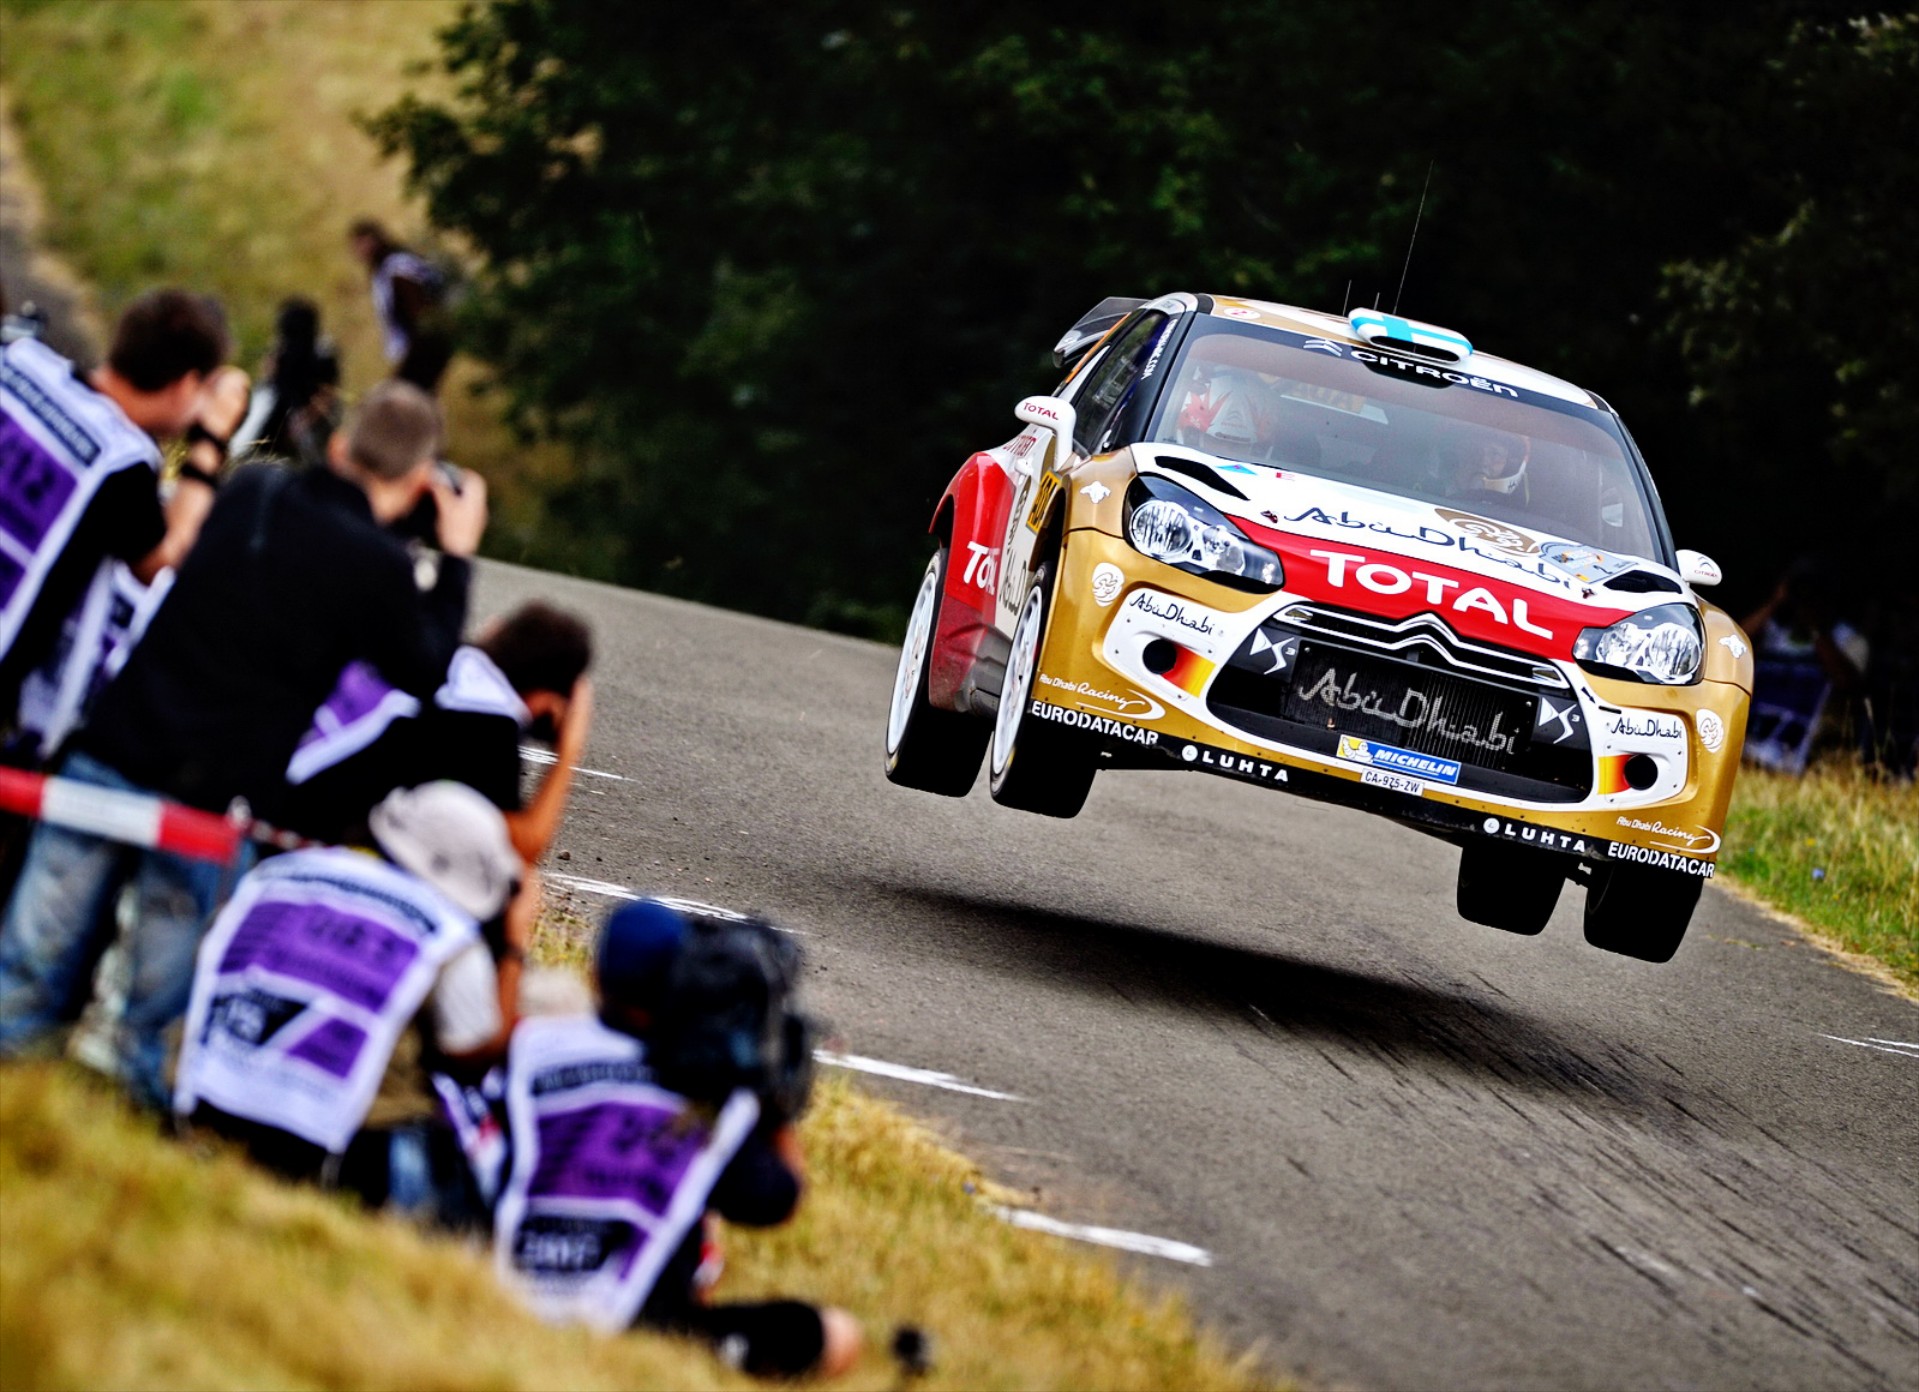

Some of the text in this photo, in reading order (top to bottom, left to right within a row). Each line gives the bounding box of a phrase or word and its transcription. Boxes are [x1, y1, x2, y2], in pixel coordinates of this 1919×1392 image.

[1023, 402, 1060, 421] TOTAL
[1310, 549, 1554, 641] TOTAL
[1039, 673, 1145, 711] Abu Dhabi Racing
[1031, 700, 1159, 745] EURODATACAR
[1202, 750, 1289, 782] LUHTA
[1374, 748, 1457, 777] MICHELIN
[1365, 770, 1420, 794] CA-975-ZW
[1504, 823, 1586, 853] LUHTA
[1652, 821, 1711, 847] Racing
[1607, 841, 1715, 878] EURODATACAR
